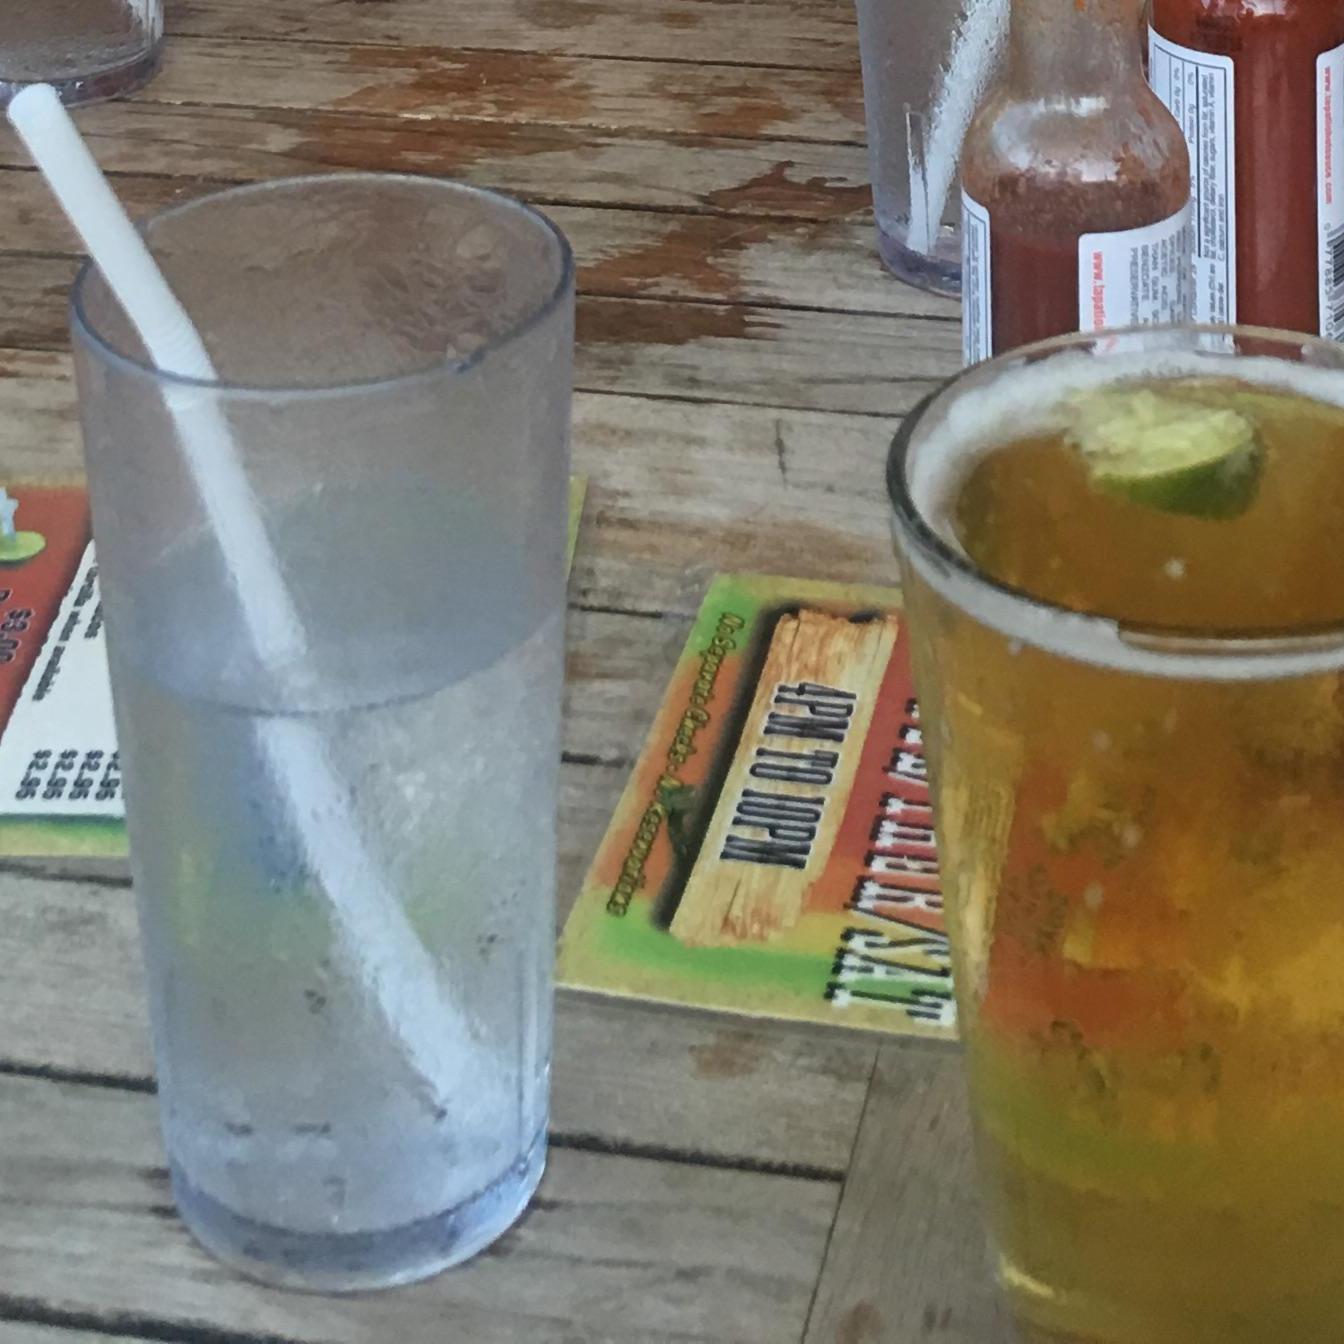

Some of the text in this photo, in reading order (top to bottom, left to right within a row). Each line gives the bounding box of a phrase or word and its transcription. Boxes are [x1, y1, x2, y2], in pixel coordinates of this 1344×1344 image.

[1092, 251, 1105, 330] www.tapatio
[688, 635, 737, 706] Separate
[665, 704, 711, 765] Checks
[15, 749, 52, 802] $2.95
[42, 749, 78, 802] $2.95
[68, 749, 103, 802] $2.95
[719, 682, 858, 870] 4PM TO 10PM
[606, 798, 668, 917] Reservations
